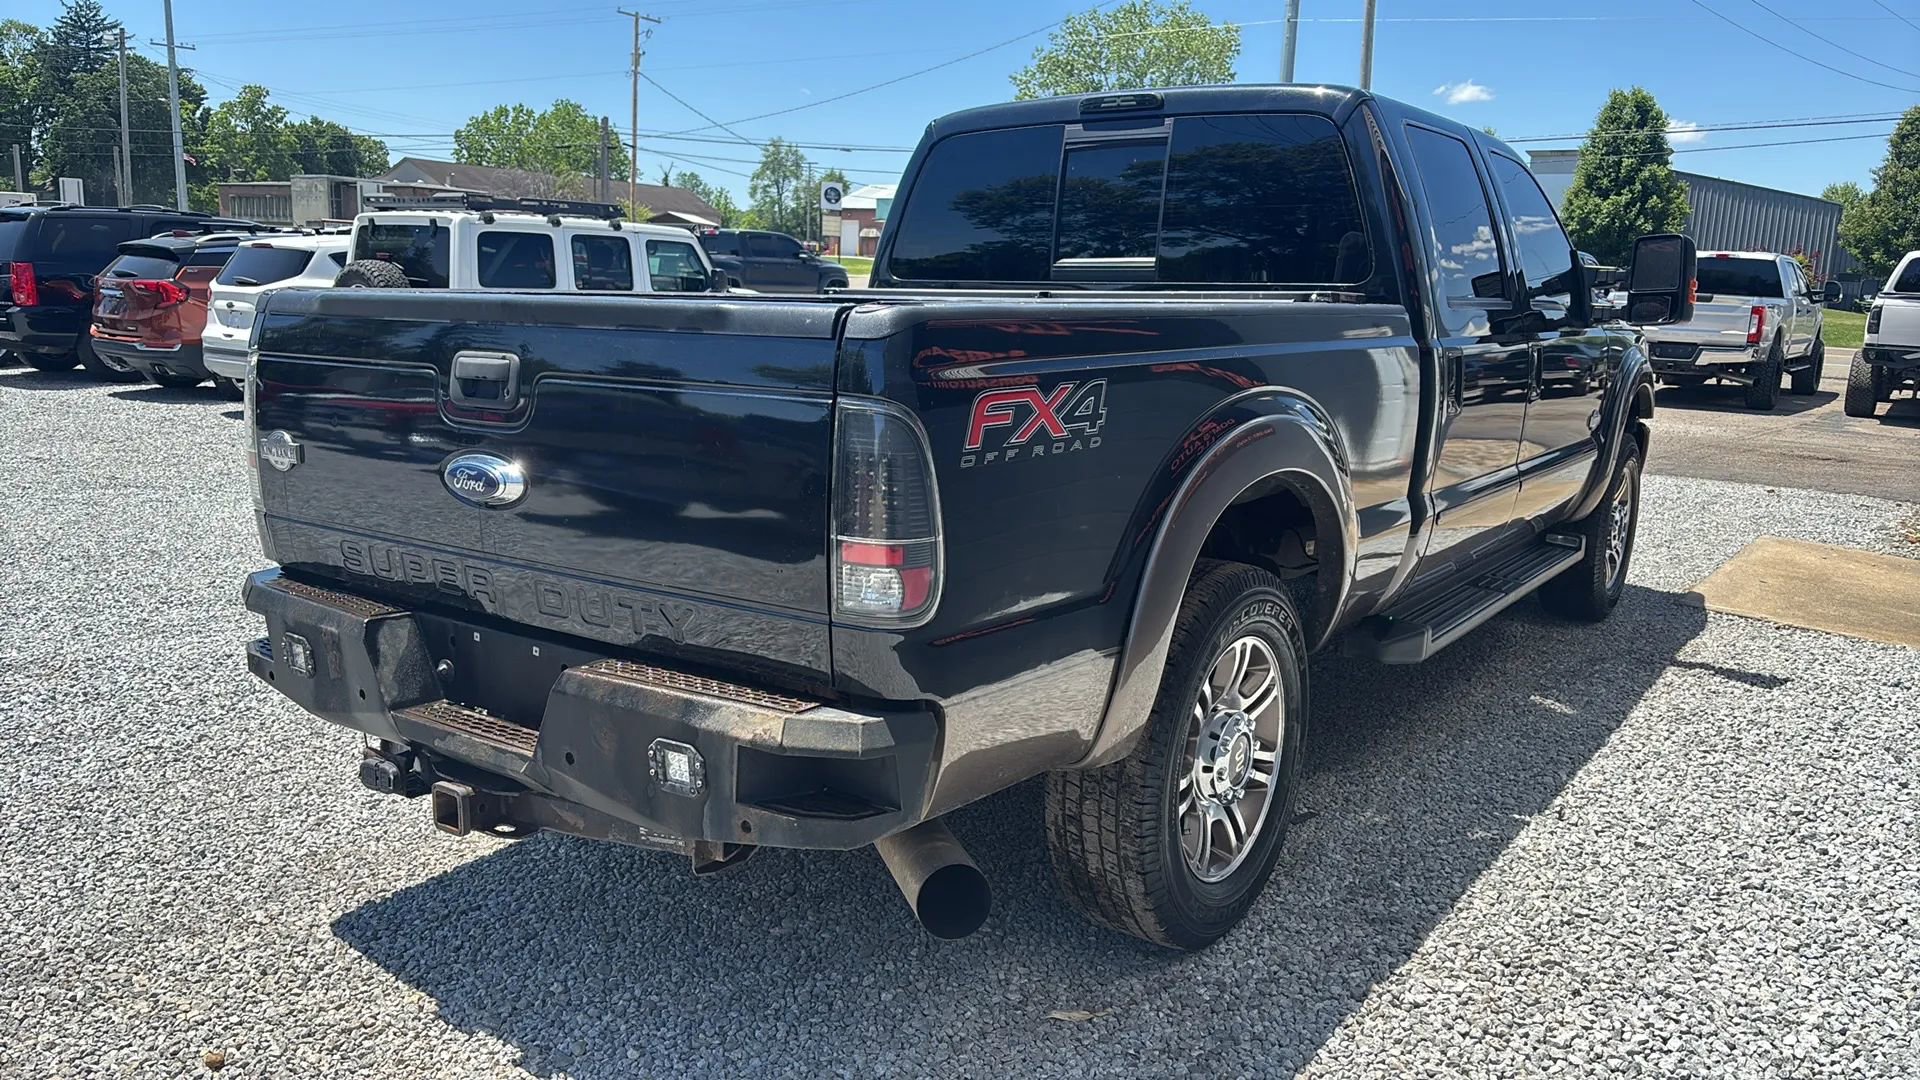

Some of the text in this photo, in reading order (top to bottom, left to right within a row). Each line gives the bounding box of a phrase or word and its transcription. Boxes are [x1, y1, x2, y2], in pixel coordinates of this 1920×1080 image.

[963, 378, 1107, 452] FX4
[960, 436, 1101, 468] OFF ROAD
[453, 467, 486, 493] Ford
[339, 539, 697, 645] SUPER DUTY
